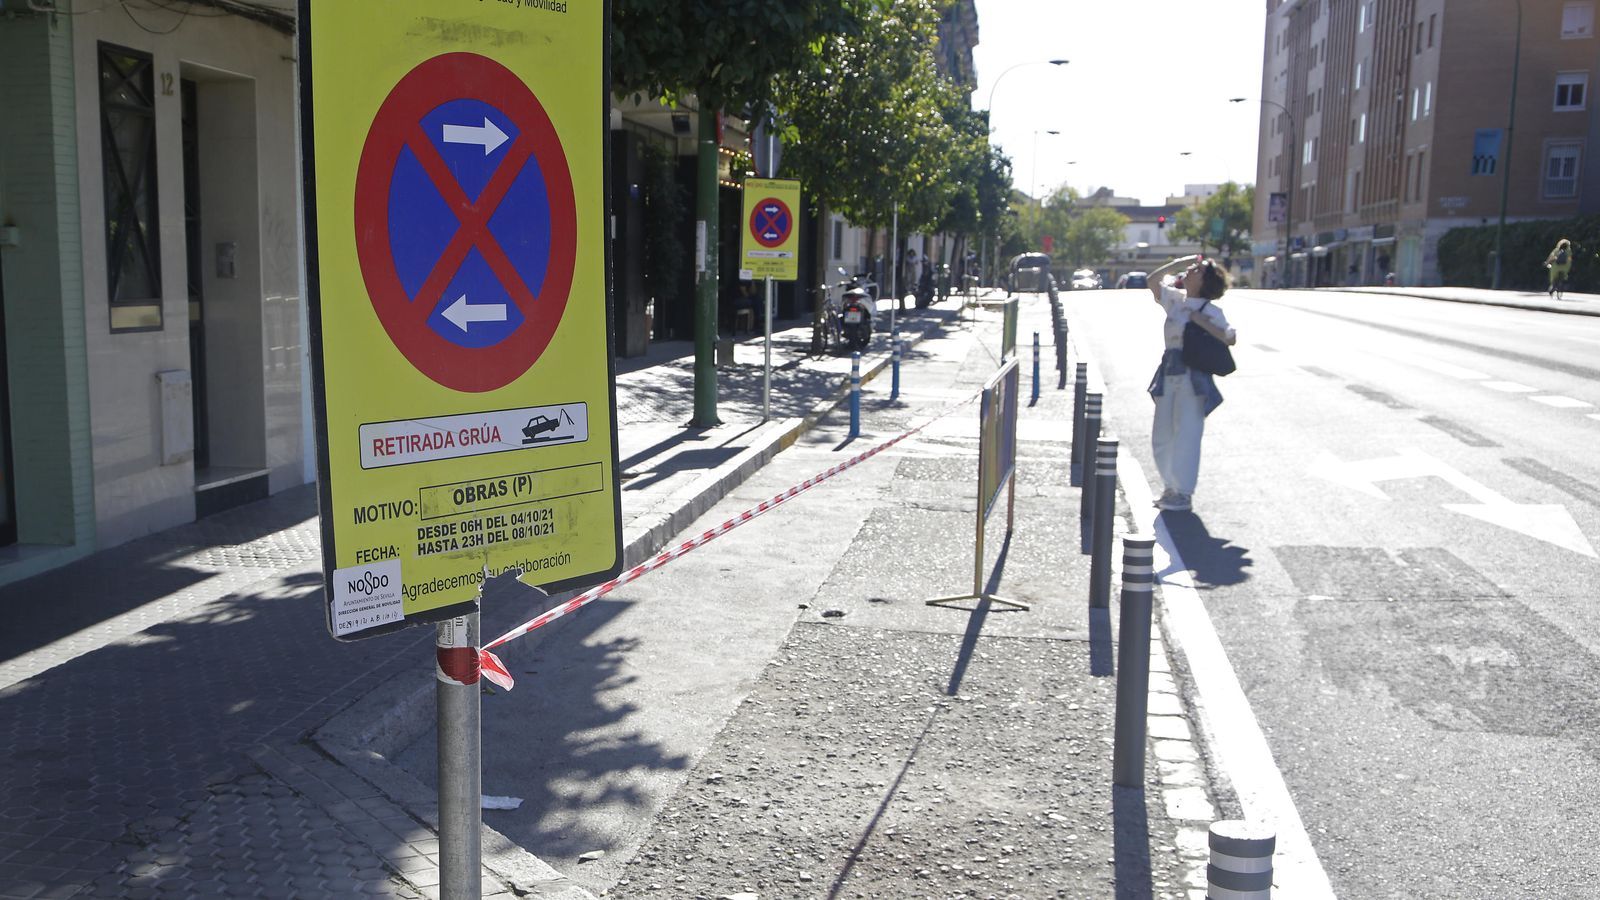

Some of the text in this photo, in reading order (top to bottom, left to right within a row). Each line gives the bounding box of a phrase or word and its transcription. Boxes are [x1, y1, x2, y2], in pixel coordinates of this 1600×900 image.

[160, 72, 174, 96] 12
[373, 423, 501, 457] RETIRADA GRÚA
[353, 475, 533, 525] MOTIVO: OBRAS (P)
[417, 508, 554, 541] DESDE 06H DEL 04/10/21
[417, 523, 555, 556] HASTA 23H DEL 08/10/21
[356, 545, 400, 564] FECHA:
[401, 573, 484, 601] Agradecemos
